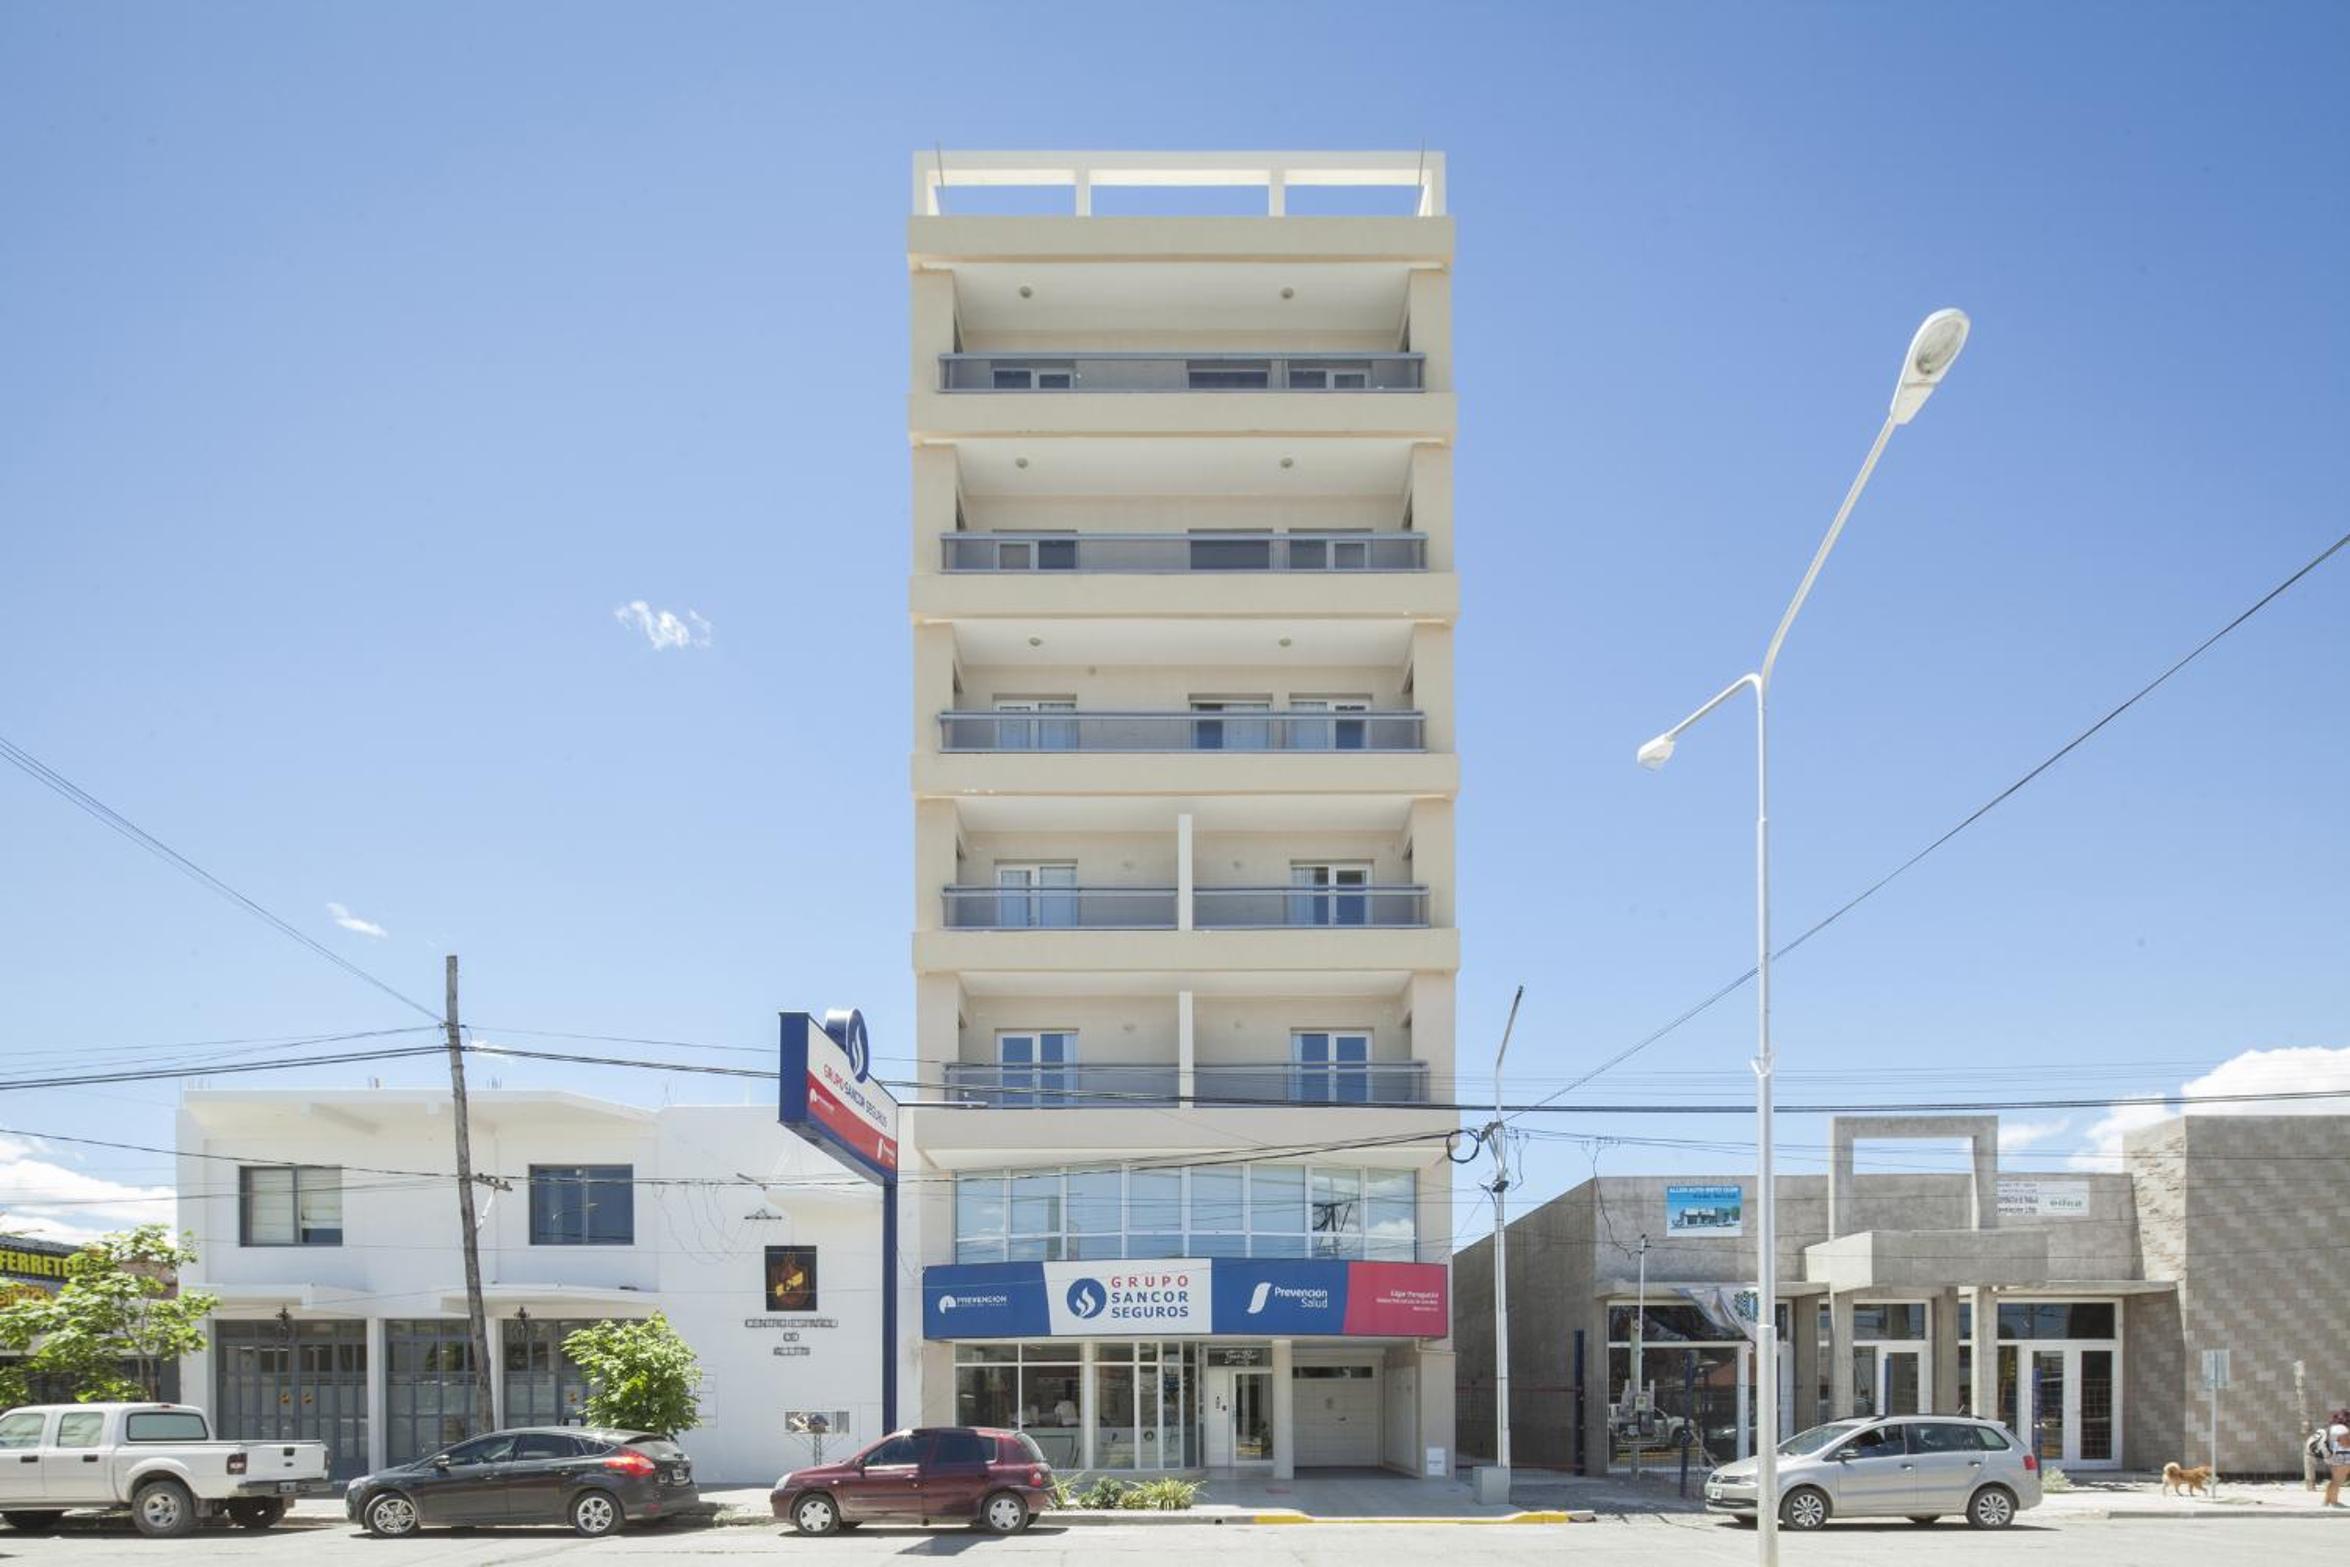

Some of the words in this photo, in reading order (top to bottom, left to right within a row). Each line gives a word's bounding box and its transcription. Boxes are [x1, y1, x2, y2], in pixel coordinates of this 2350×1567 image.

[1111, 1276, 1189, 1289] GRUPO
[1111, 1291, 1189, 1303] SANCOR
[1300, 1297, 1328, 1308] Salud
[1111, 1306, 1189, 1318] SEGUROS
